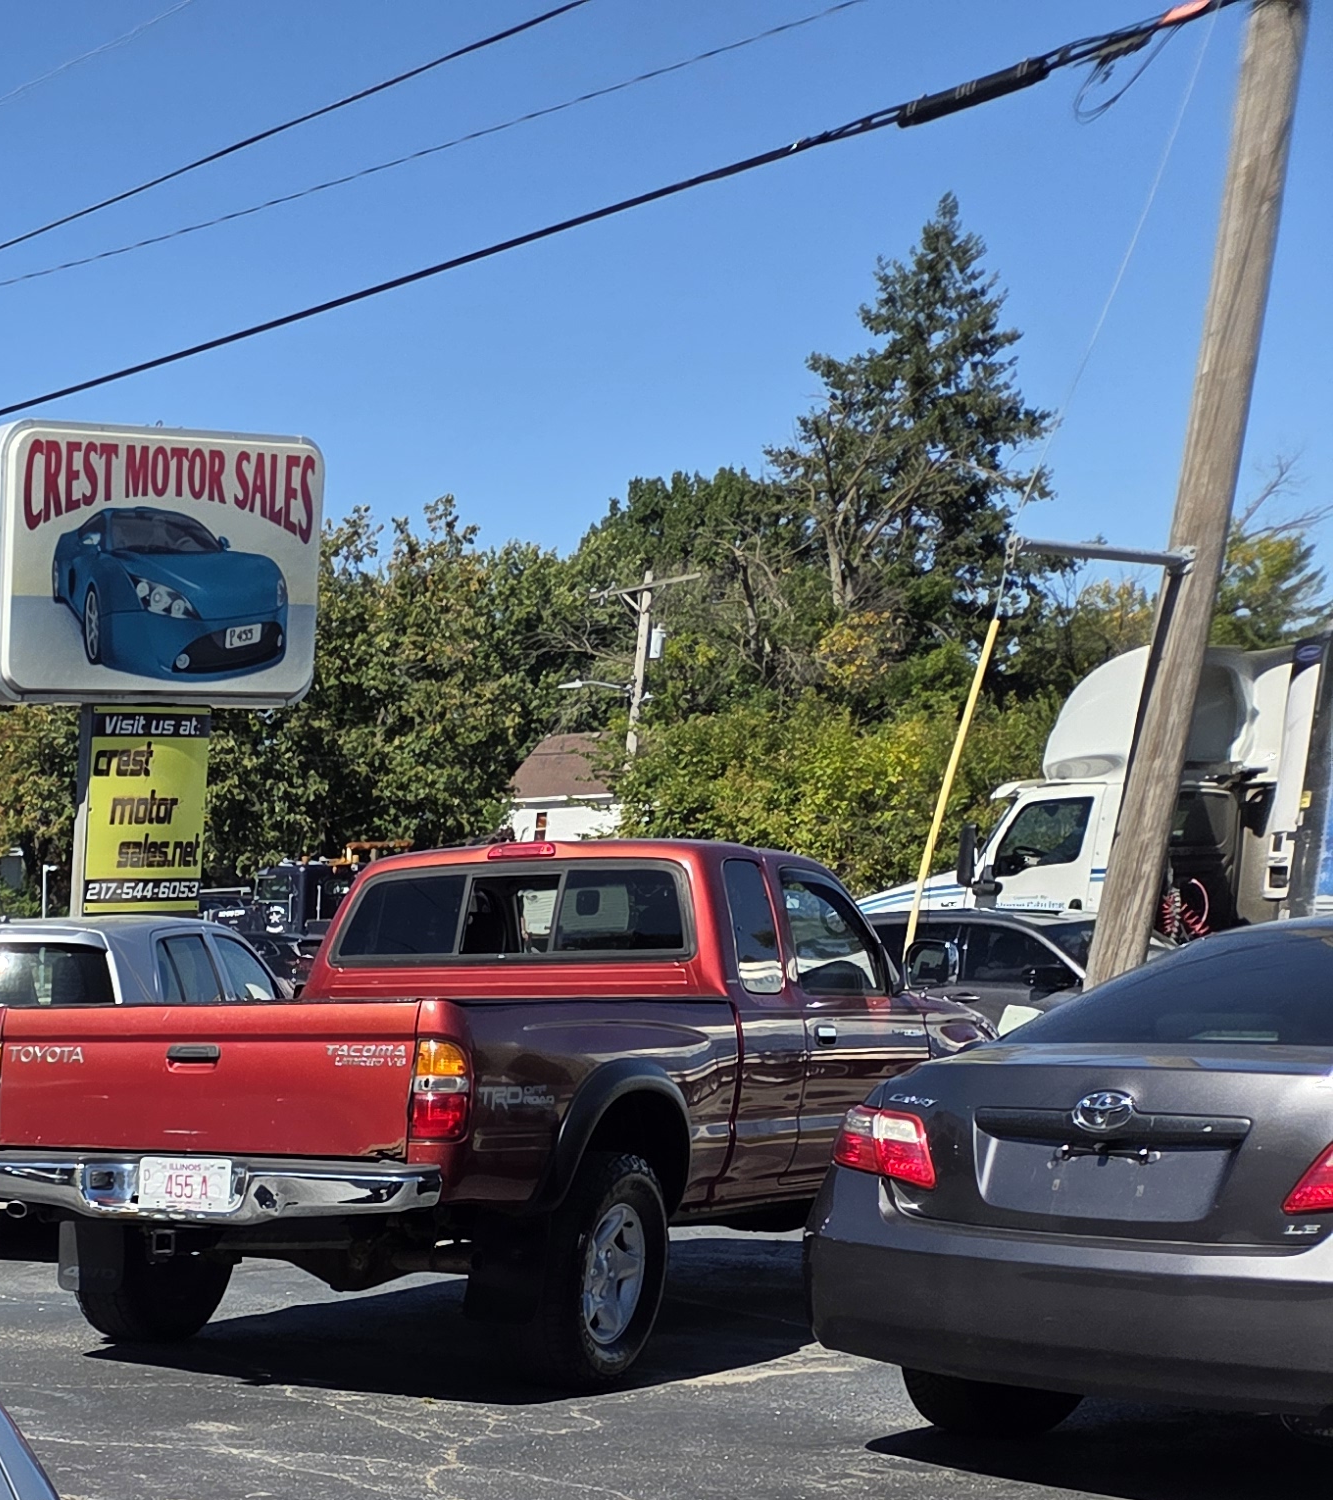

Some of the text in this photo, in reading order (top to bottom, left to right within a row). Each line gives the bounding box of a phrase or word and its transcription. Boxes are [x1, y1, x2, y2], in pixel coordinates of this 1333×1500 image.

[23, 439, 316, 545] CREST MOTOR SALES
[105, 715, 201, 735] Visit us at:
[93, 740, 155, 777] crest
[109, 789, 179, 825] motor
[116, 833, 201, 869] sales.net
[86, 882, 200, 900] 217-544-6053
[8, 1045, 84, 1064] TOYOTA
[325, 1044, 406, 1056] TACOMA
[478, 1086, 523, 1111] TRD
[169, 1163, 202, 1172] ILLINOIS
[165, 1174, 194, 1199] 455
[199, 1175, 209, 1200] A
[1283, 1224, 1321, 1235] LE
